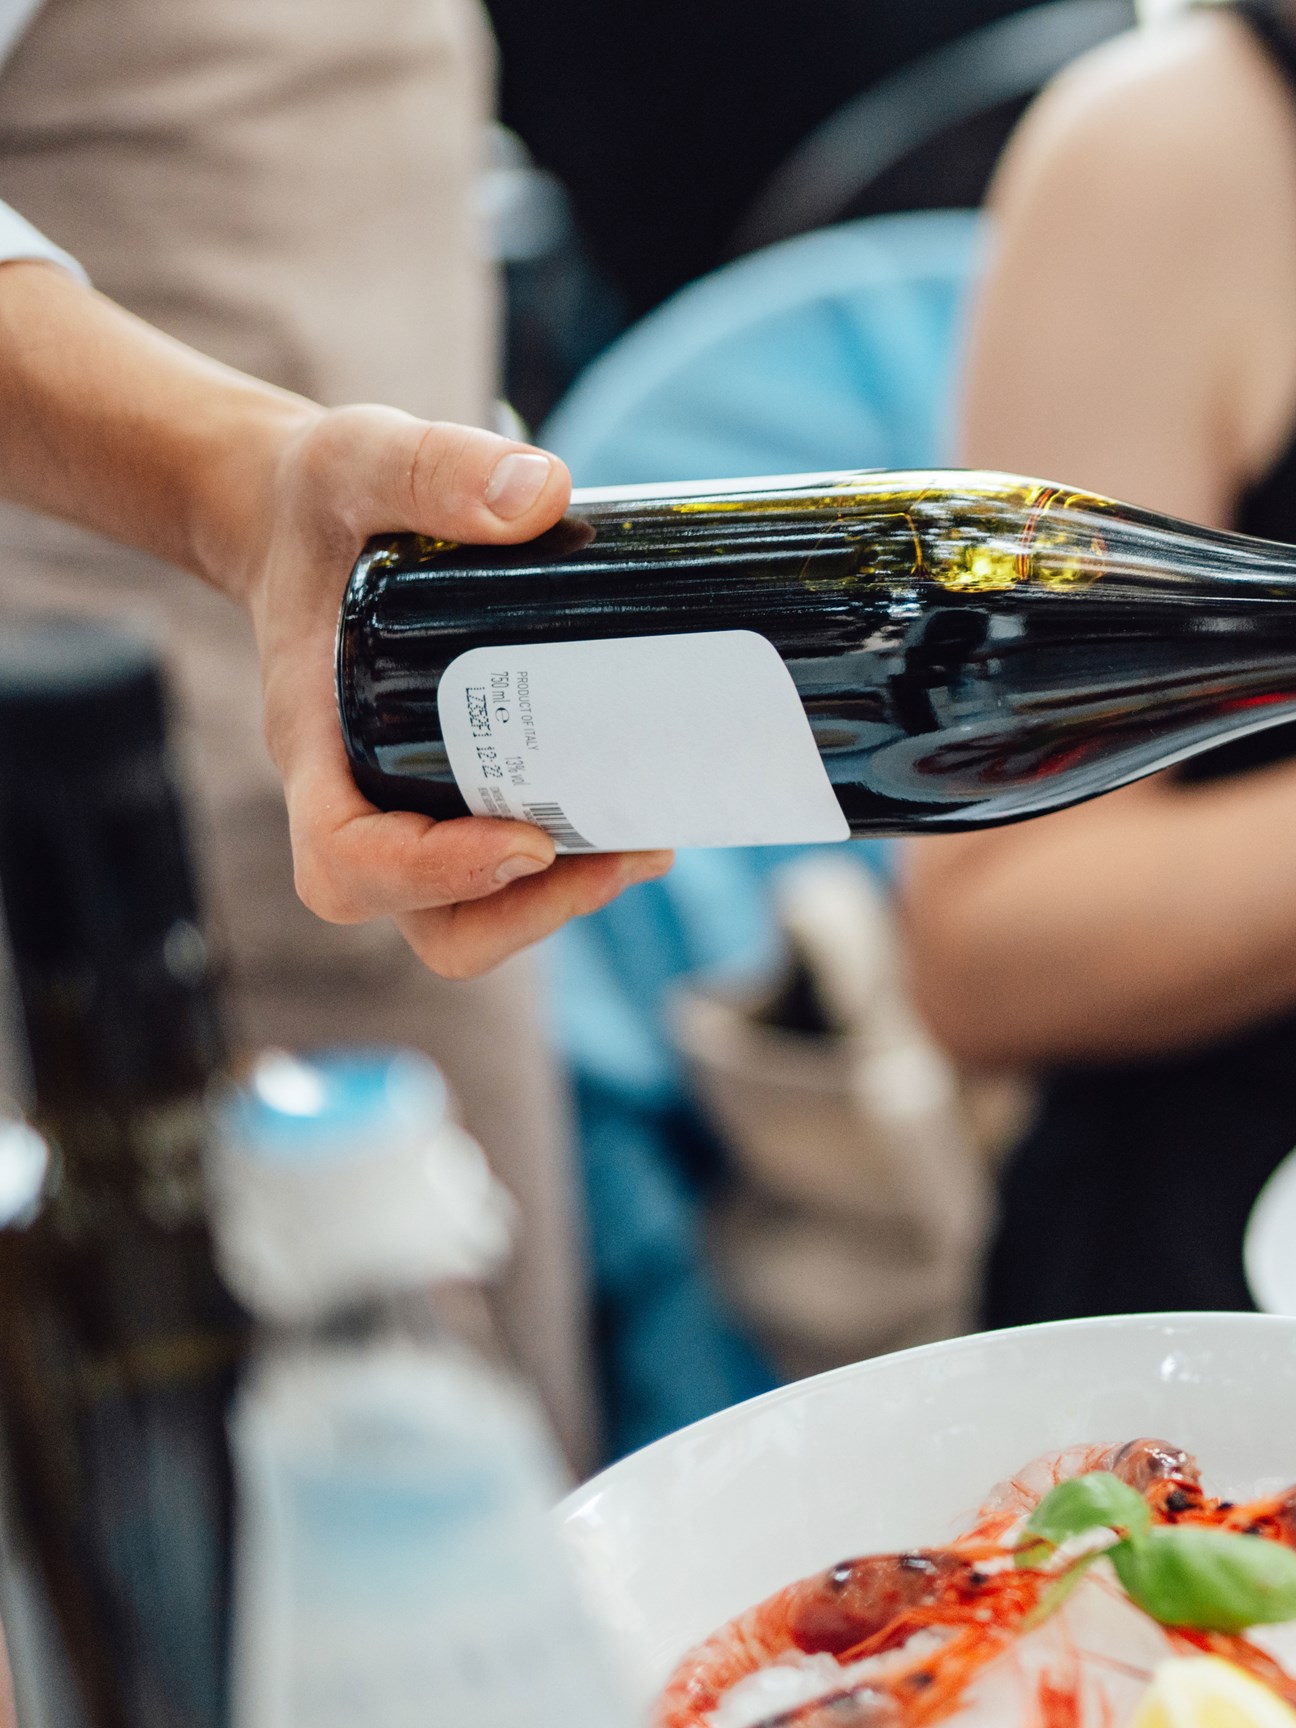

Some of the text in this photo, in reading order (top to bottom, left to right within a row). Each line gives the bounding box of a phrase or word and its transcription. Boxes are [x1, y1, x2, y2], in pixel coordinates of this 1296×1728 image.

[490, 671, 509, 689] 750
[493, 691, 511, 703] ml
[517, 671, 539, 750] PRODUCT OF ITALY
[505, 756, 530, 786] 13% vol
